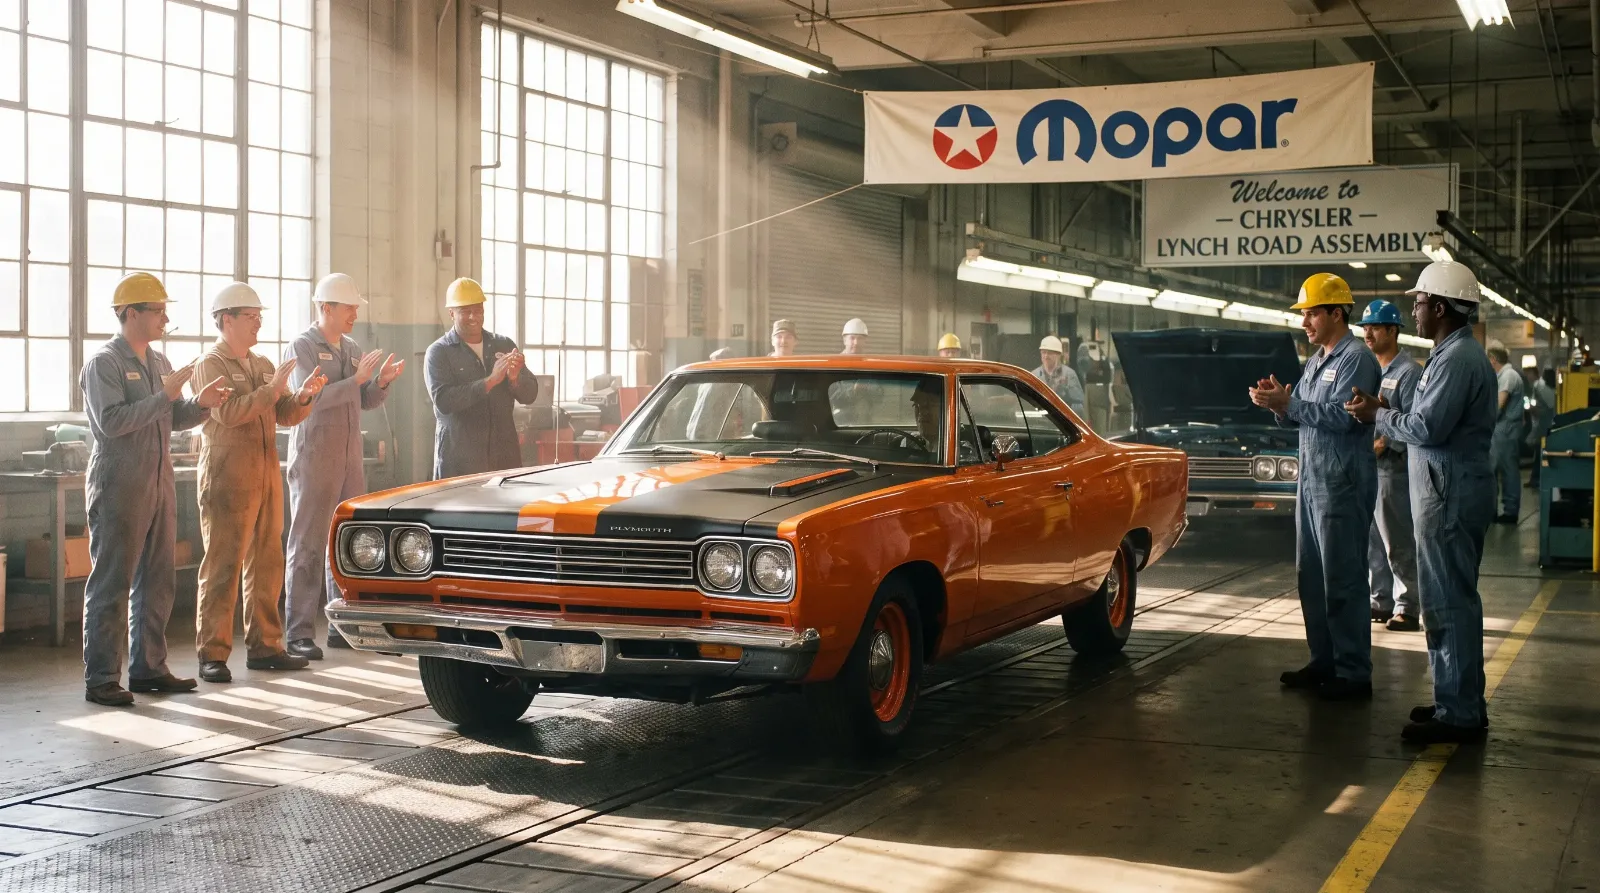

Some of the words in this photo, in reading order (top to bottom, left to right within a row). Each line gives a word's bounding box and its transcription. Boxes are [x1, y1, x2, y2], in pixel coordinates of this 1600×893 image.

[1230, 179, 1328, 203] Welcome
[1338, 179, 1360, 200] to
[1240, 207, 1353, 229] CHRYSLER
[1157, 237, 1228, 257] LYNCH
[1237, 235, 1303, 255] ROAD
[1310, 231, 1426, 253] ASSEMBLY
[610, 525, 672, 533] PLYMOUTH
